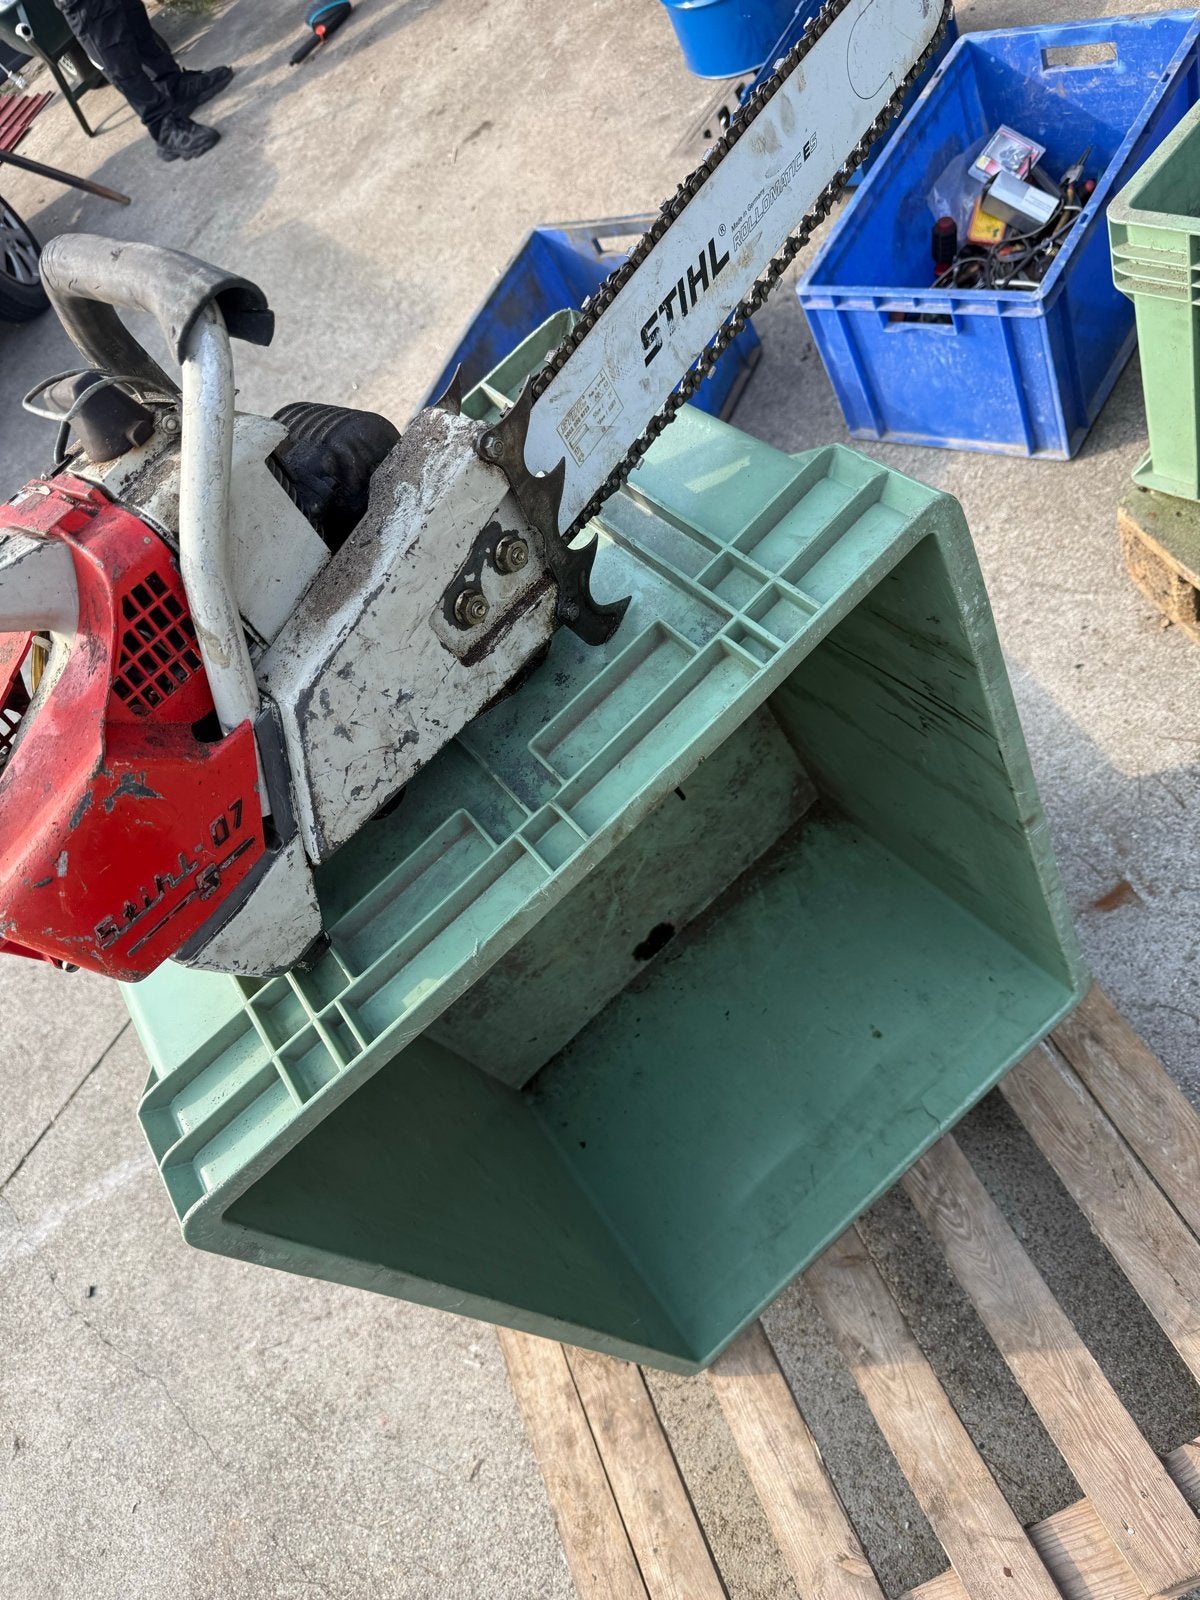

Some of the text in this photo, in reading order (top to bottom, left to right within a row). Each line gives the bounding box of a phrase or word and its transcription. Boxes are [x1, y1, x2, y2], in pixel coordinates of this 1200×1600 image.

[731, 215, 743, 233] Made
[747, 188, 765, 212] Germany
[733, 131, 818, 252] ROLLOMATIC ES
[640, 238, 730, 368] STIHL
